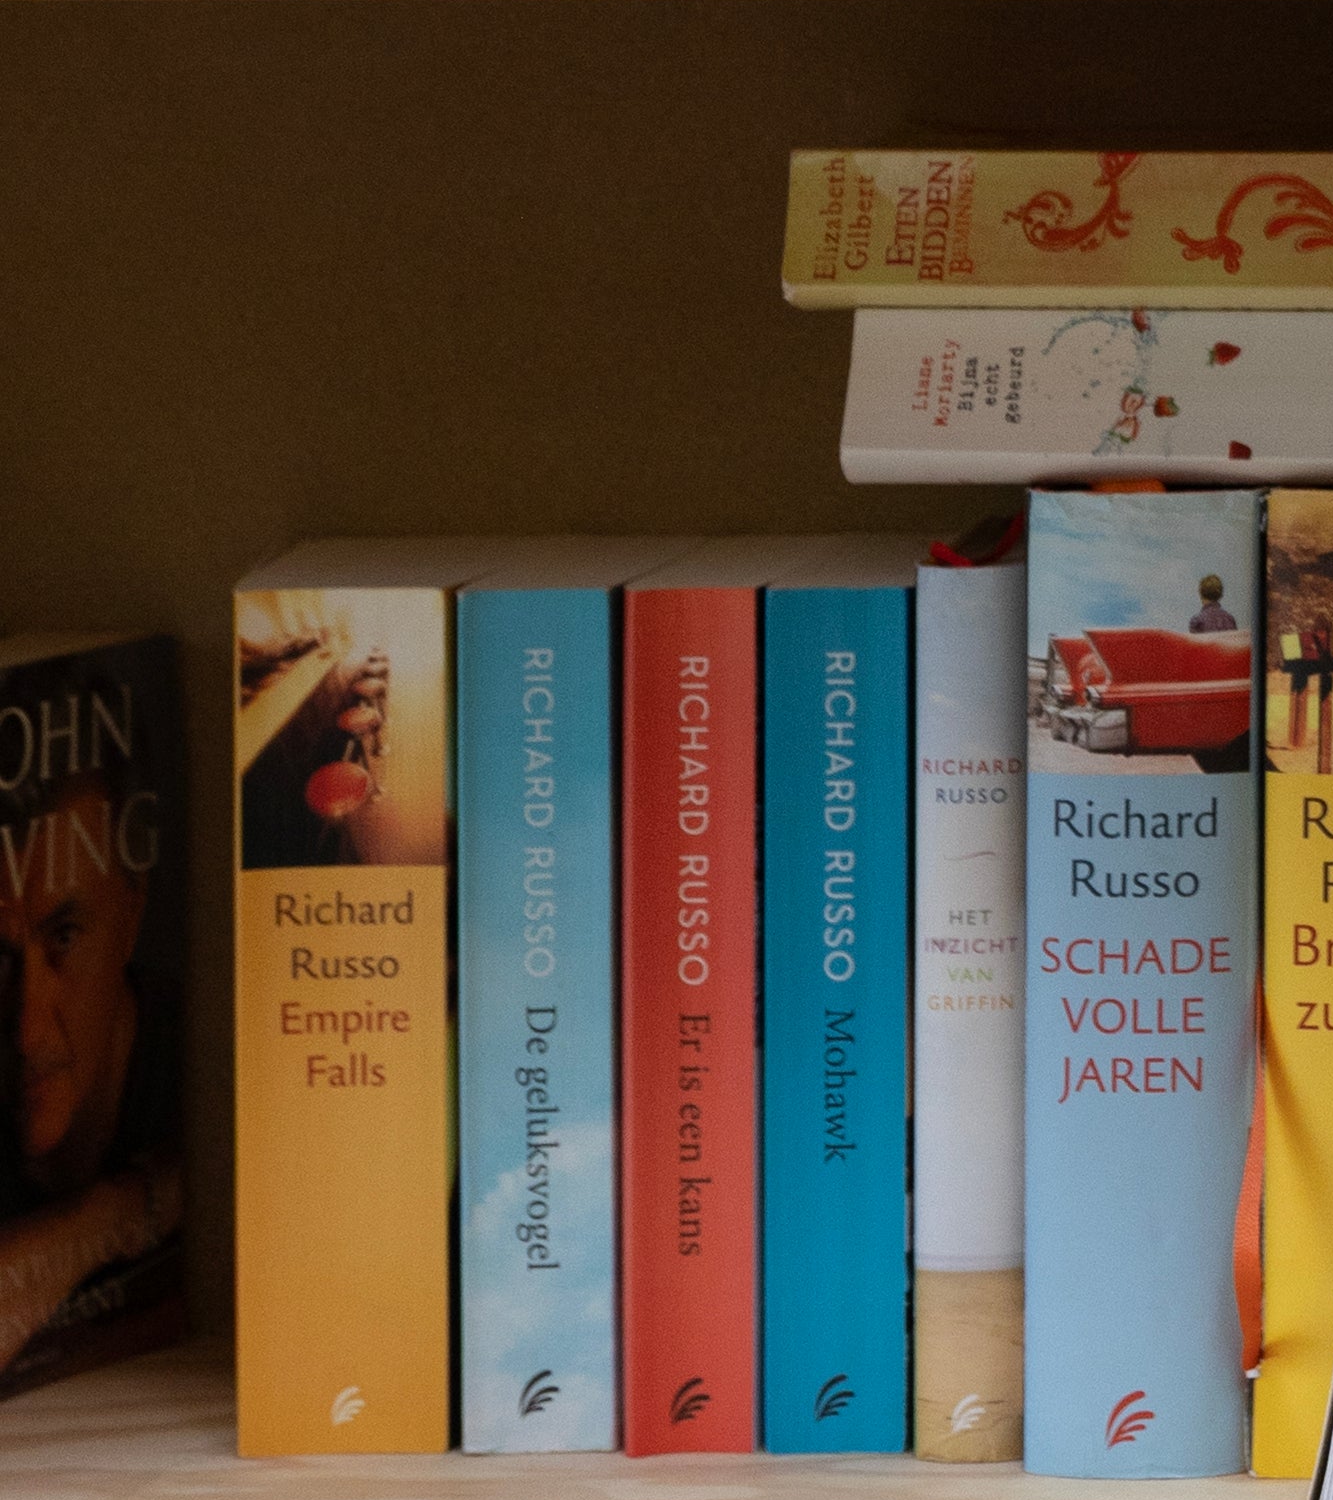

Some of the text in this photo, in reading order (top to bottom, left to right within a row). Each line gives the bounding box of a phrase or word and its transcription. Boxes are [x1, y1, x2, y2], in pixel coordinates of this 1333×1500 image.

[273, 891, 415, 928] Richard
[824, 651, 858, 1165] RICHARD RUSSO Mohawk
[289, 948, 400, 982] Russo
[1041, 937, 1232, 976] SCHADE
[279, 1004, 412, 1043] Empire
[1062, 996, 1205, 1035] VOLLE
[305, 1055, 387, 1089] Falls
[1057, 1056, 1203, 1103] JAREN
